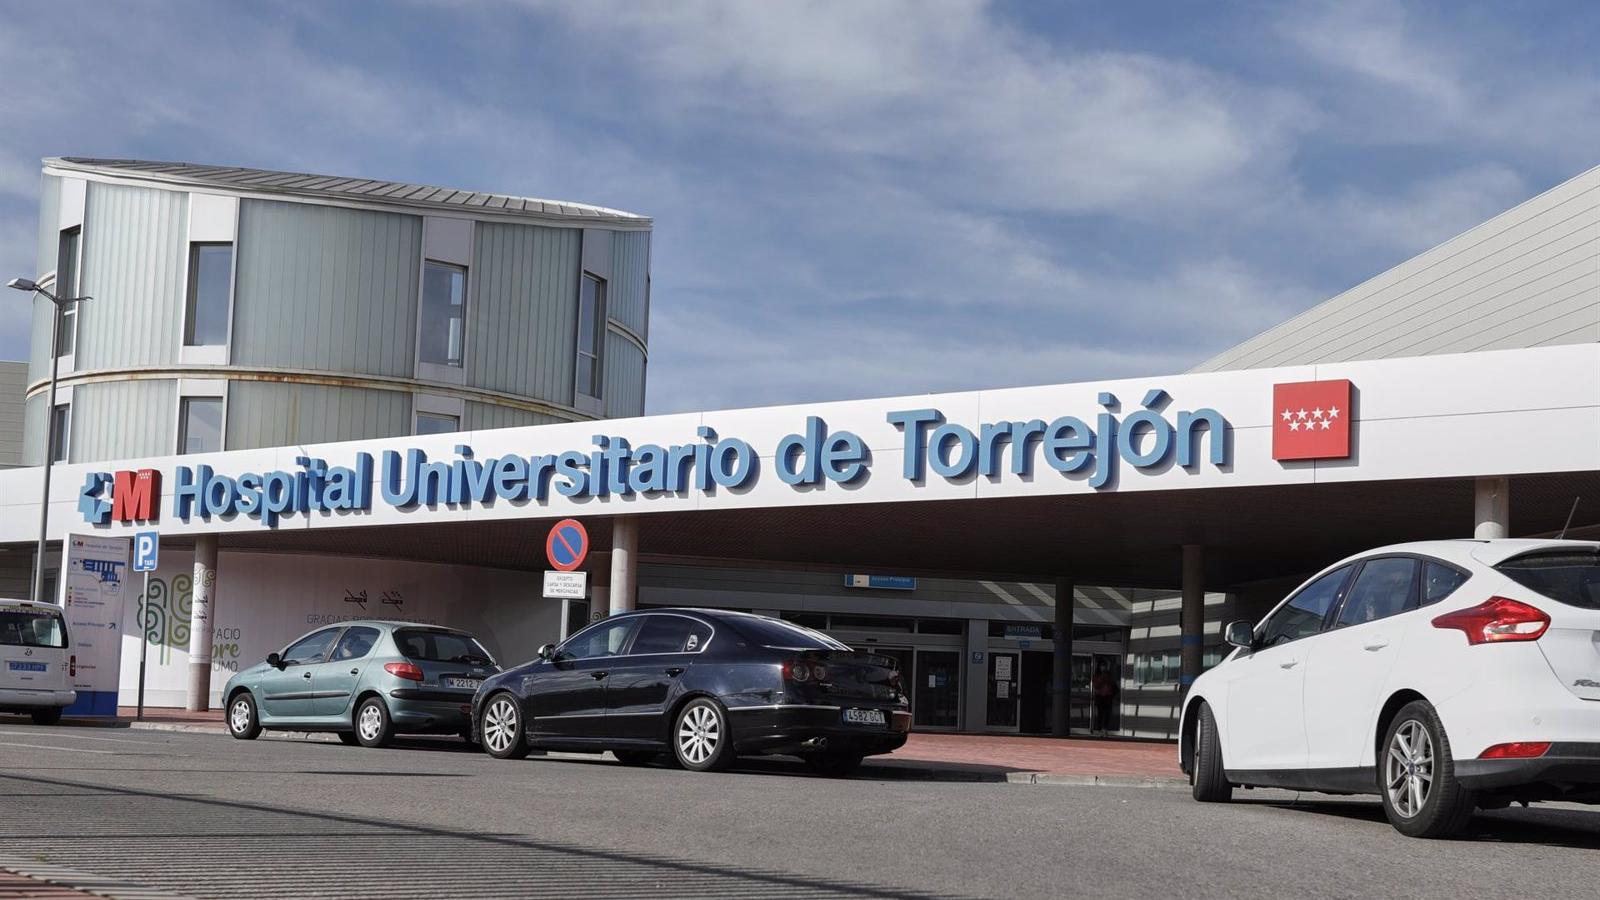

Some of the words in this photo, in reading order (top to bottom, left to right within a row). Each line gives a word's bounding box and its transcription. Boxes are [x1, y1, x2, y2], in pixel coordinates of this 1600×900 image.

[173, 452, 373, 526] Hospital
[381, 426, 757, 507] Universitario
[775, 416, 868, 487] de
[887, 389, 1230, 490] Torrejón
[137, 536, 153, 567] P
[456, 679, 473, 688] 2212
[848, 710, 868, 722] 4582
